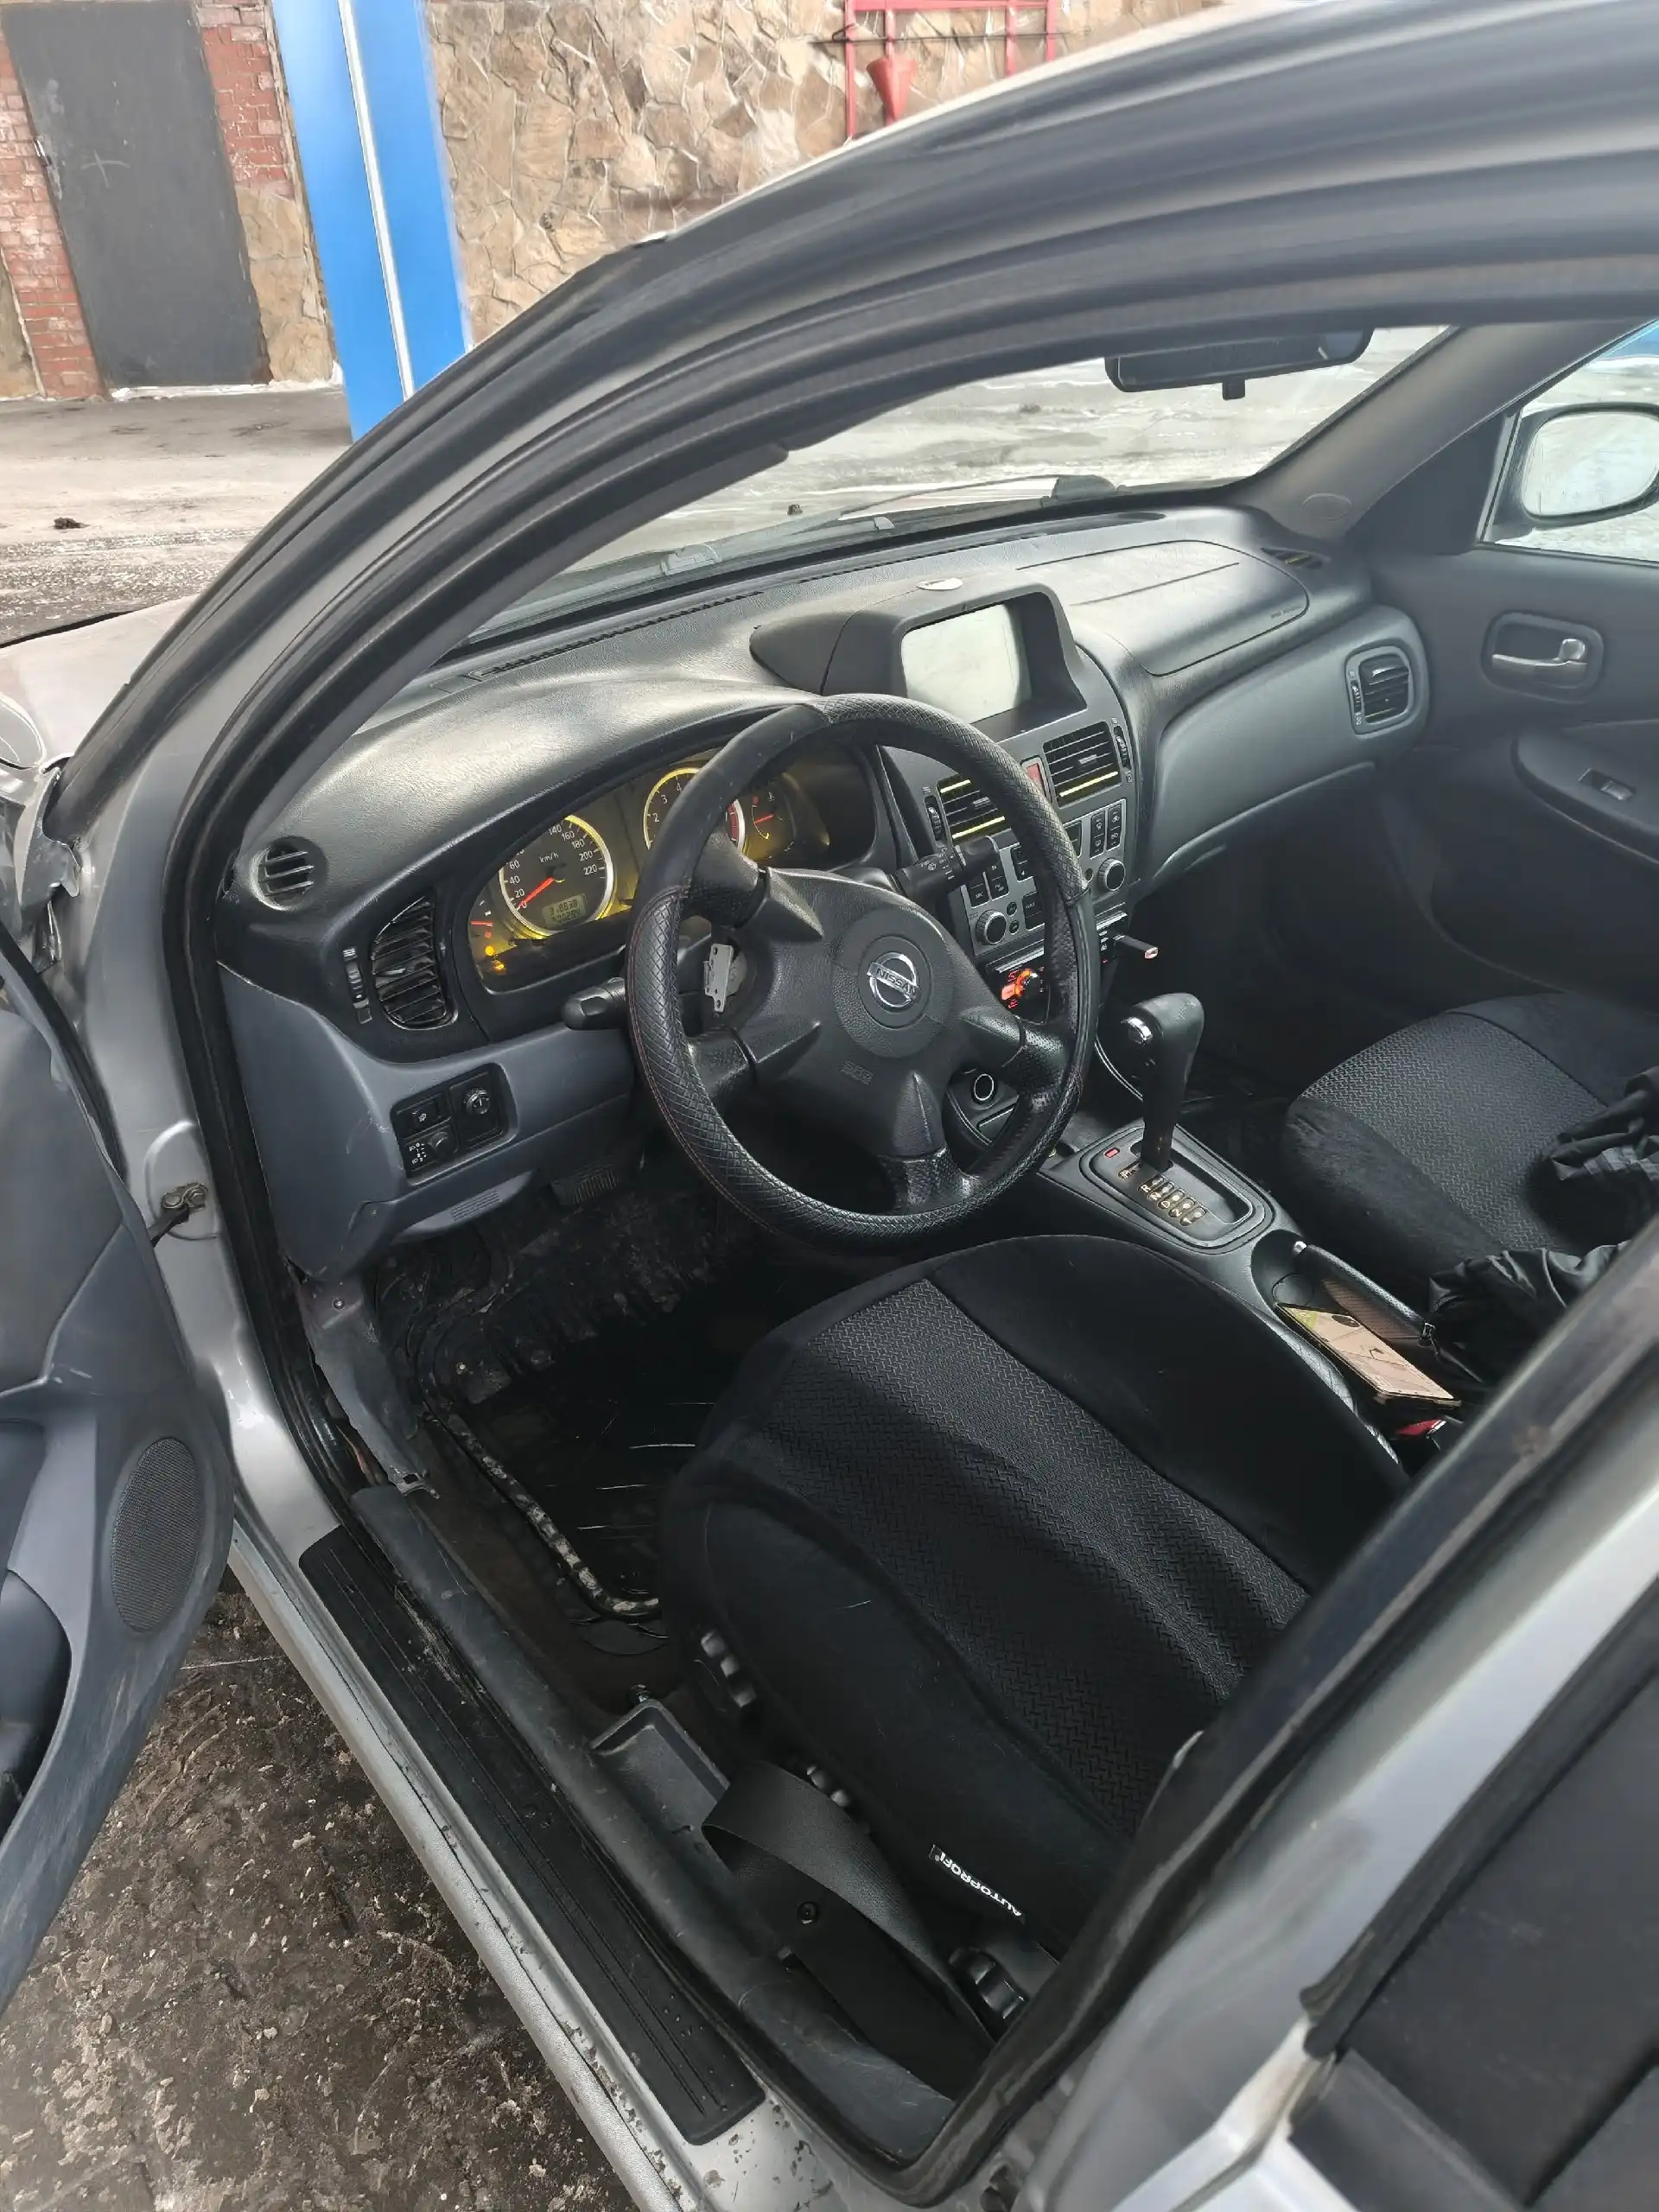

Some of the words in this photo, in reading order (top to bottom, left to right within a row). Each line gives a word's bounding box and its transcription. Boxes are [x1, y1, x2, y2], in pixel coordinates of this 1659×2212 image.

[675, 782, 683, 791] 4
[661, 794, 669, 804] 3
[652, 812, 660, 823] 2
[548, 823, 563, 836] 140
[561, 830, 575, 842] 160
[571, 838, 585, 849] 180
[538, 851, 559, 863] km/h
[578, 850, 594, 861] 200
[509, 860, 521, 870] 60
[582, 864, 598, 875] 220
[509, 874, 521, 885] 40
[513, 888, 525, 899] 20
[876, 967, 916, 995] NISSAN
[1140, 1184, 1152, 1193] R
[1149, 1191, 1162, 1201] N
[1160, 1200, 1171, 1209] D
[1171, 1208, 1183, 1217] 2
[938, 1852, 1022, 1916] AUTOPROFI
